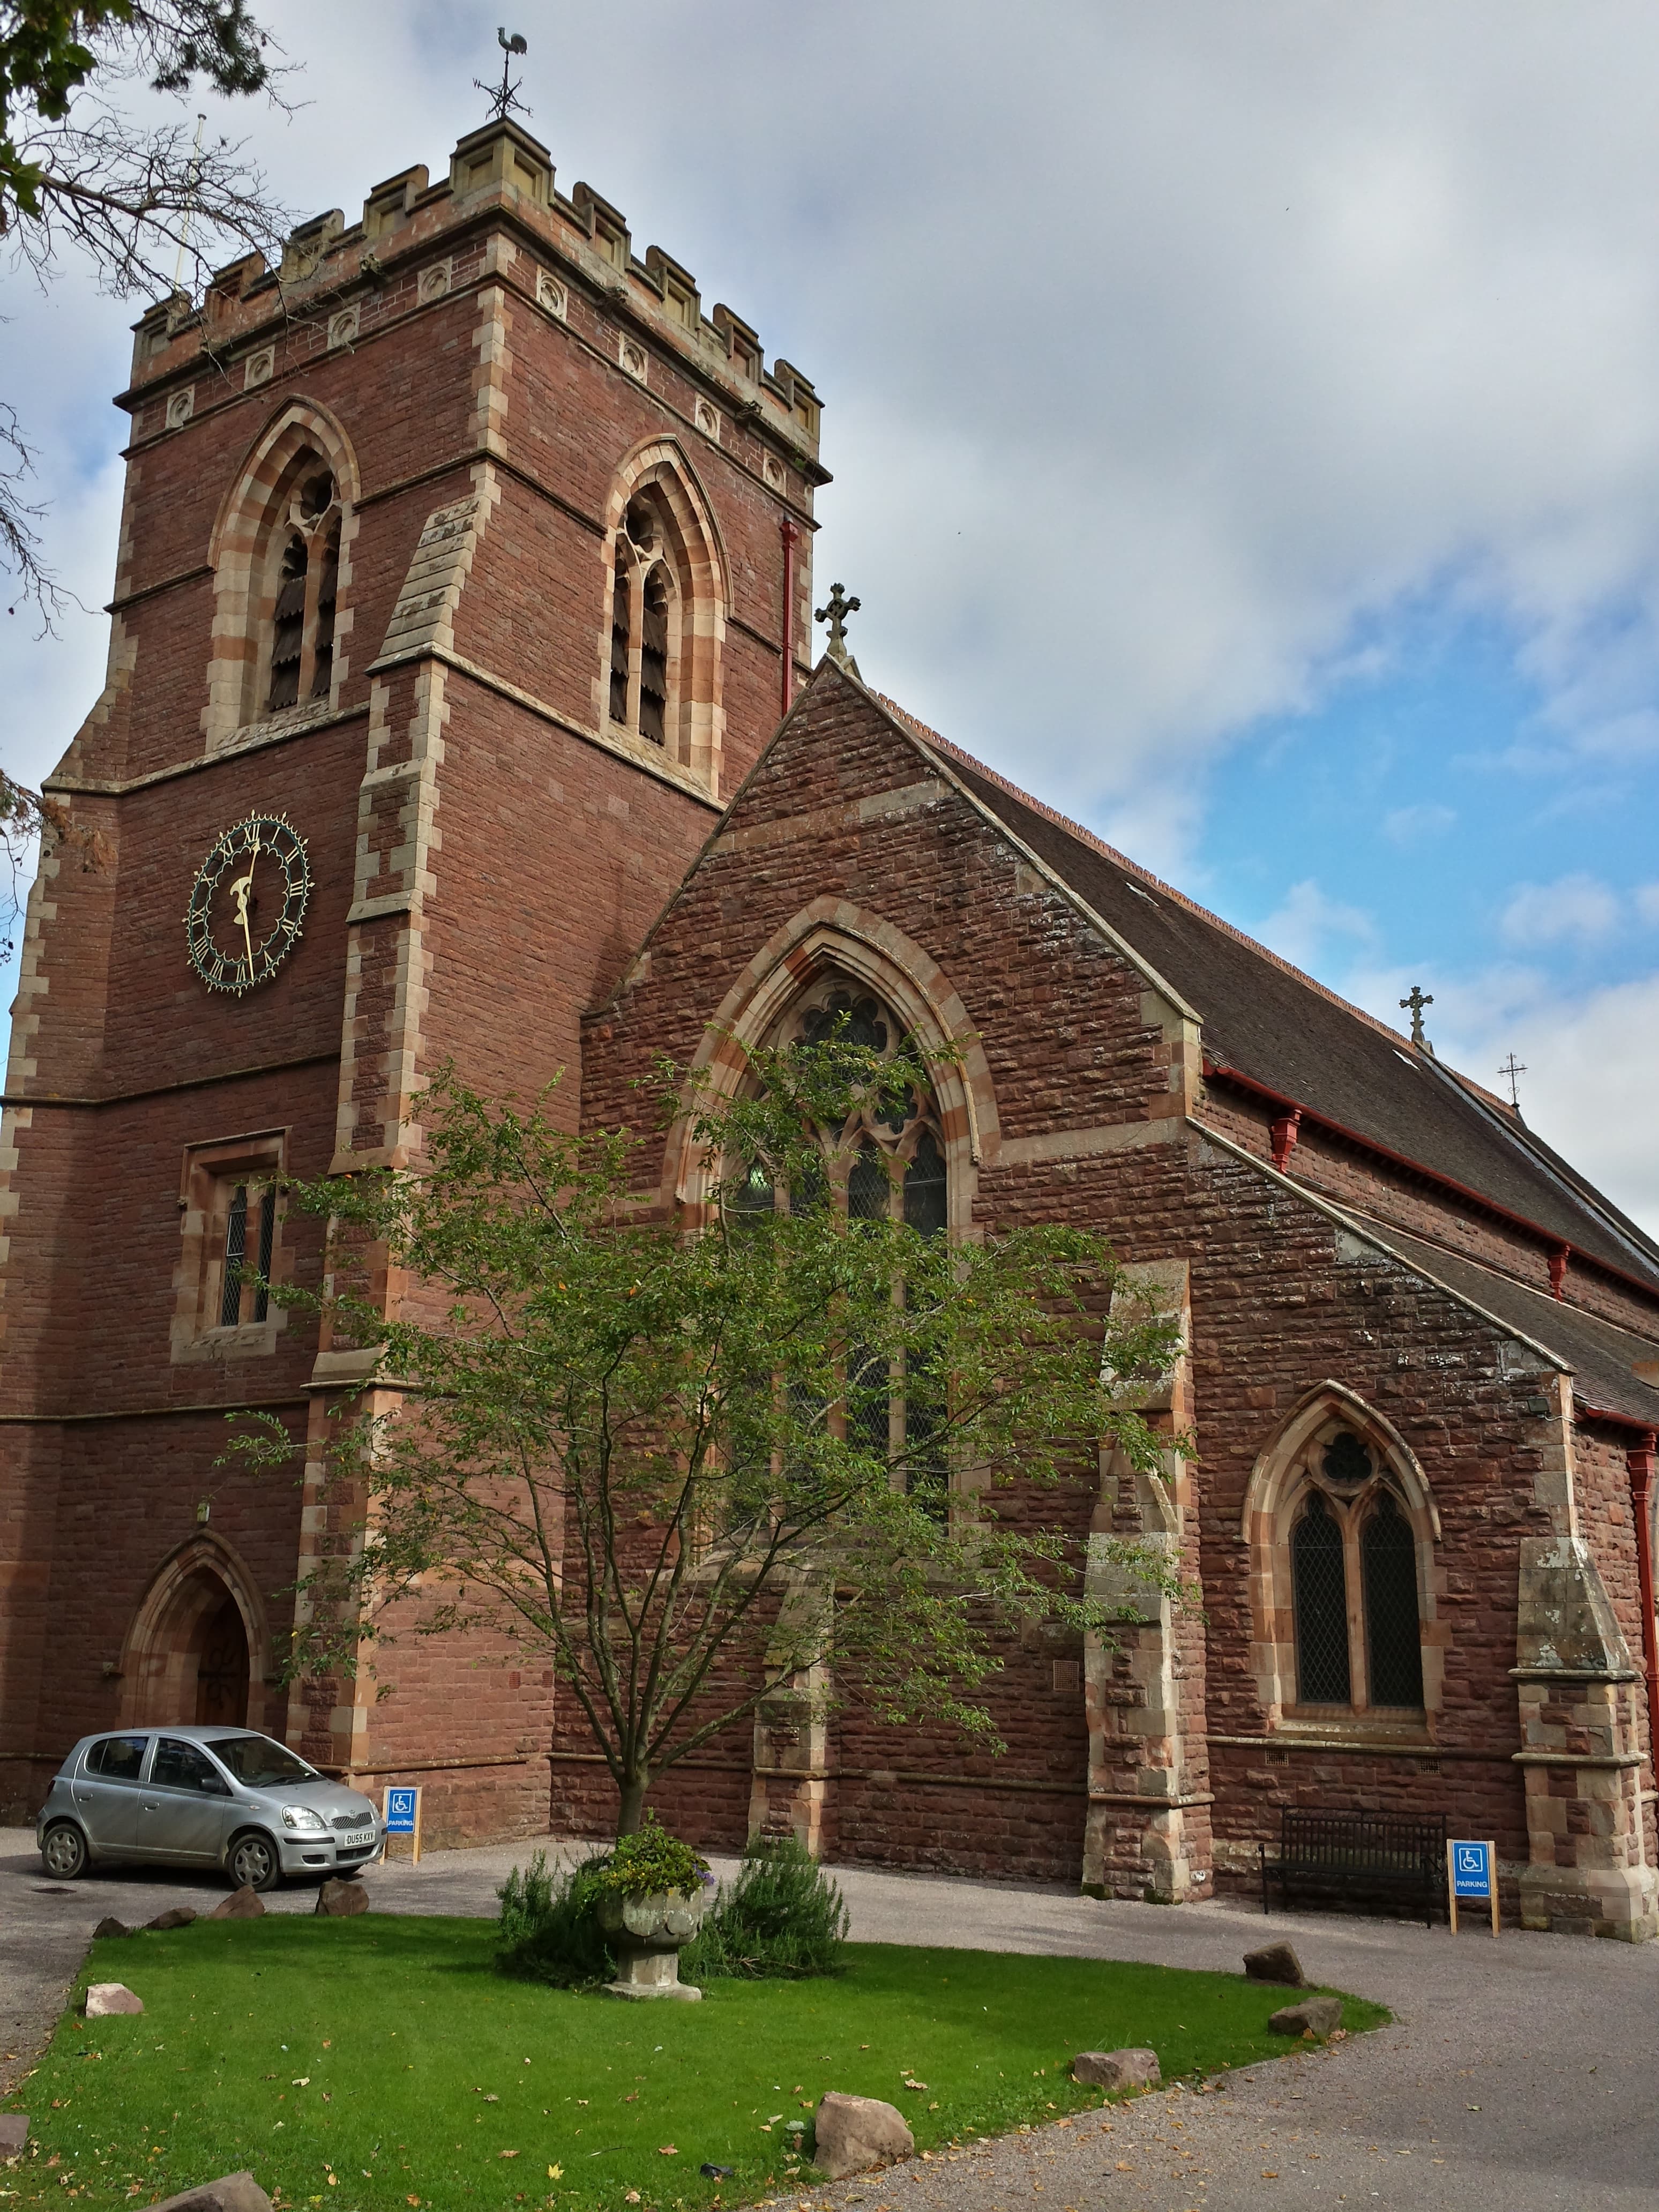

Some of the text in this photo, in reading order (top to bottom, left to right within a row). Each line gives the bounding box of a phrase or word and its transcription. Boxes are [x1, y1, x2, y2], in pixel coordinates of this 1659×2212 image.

[243, 823, 261, 845] XII
[271, 826, 281, 844] I
[219, 839, 234, 862] XI
[285, 846, 299, 864] II
[200, 873, 214, 887] X
[290, 879, 303, 898] III
[192, 906, 204, 926] IX
[282, 917, 296, 936] IV
[194, 935, 209, 963] VIII
[265, 950, 273, 967] V
[209, 959, 224, 981] VII
[236, 965, 246, 983] VI
[347, 1832, 373, 1844] DU55 KXV
